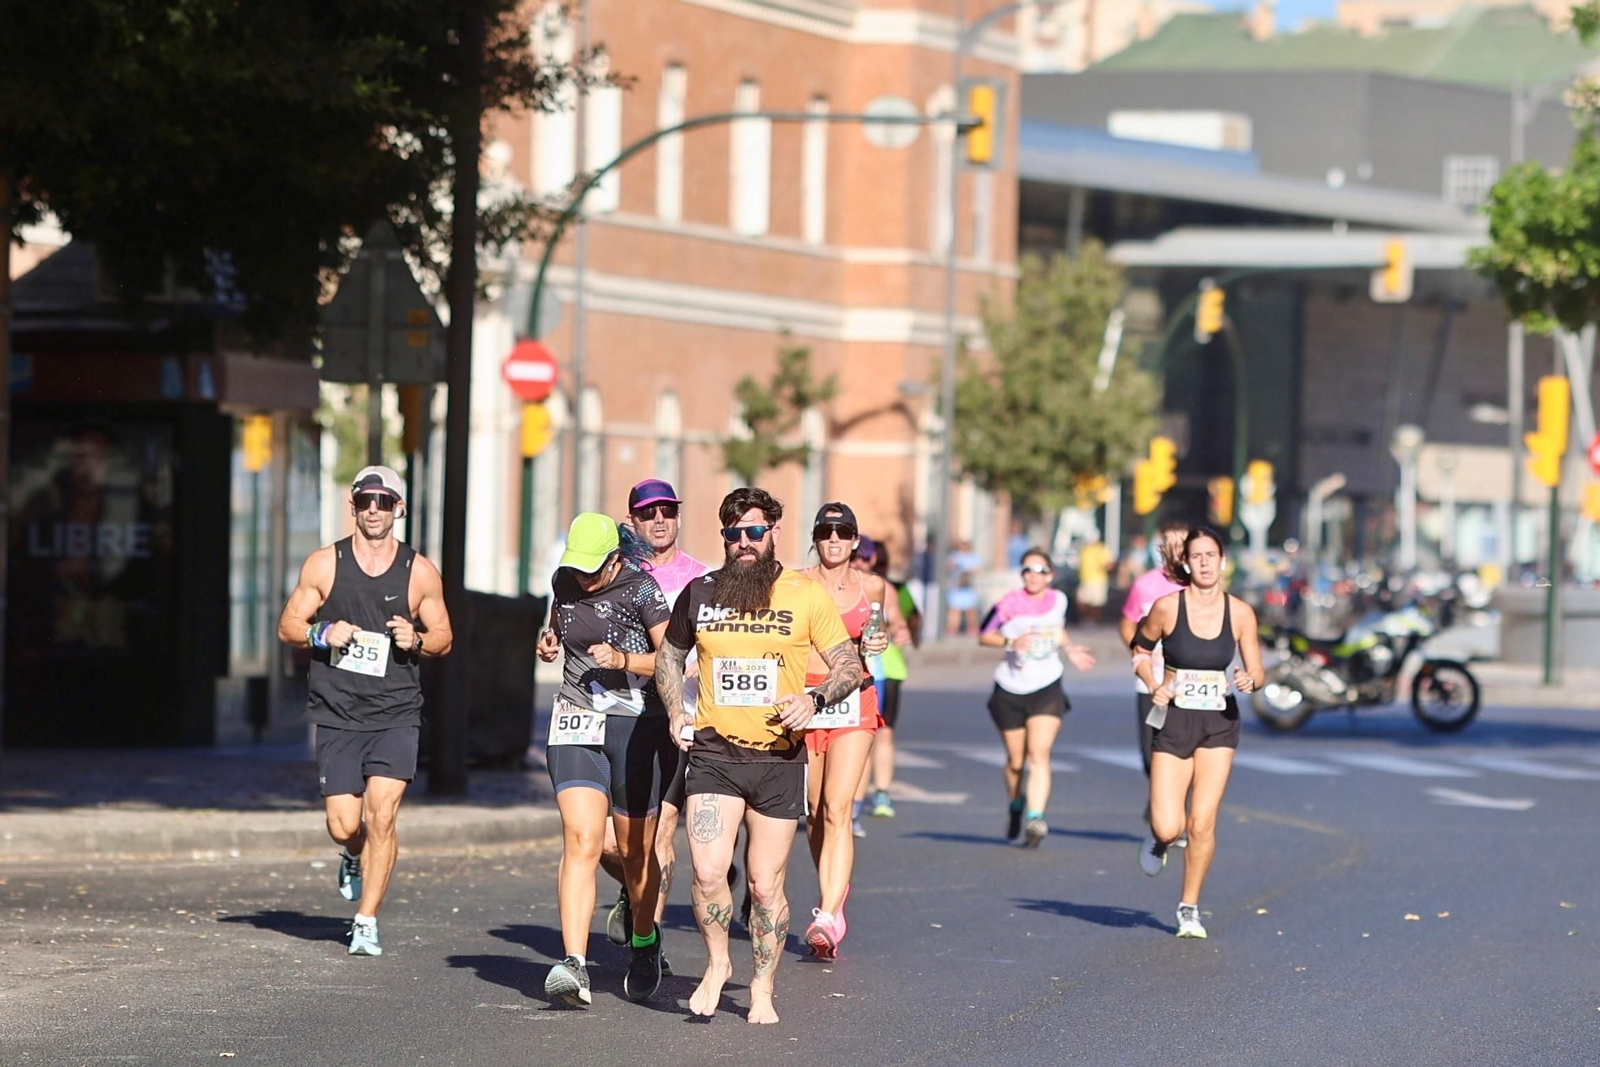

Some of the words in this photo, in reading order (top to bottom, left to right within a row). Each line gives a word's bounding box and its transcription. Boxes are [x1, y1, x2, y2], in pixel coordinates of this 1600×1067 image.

[28, 522, 151, 557] LIBRE
[696, 622, 791, 635] runners
[722, 674, 768, 690] 586
[1184, 684, 1218, 697] 241
[818, 701, 850, 715] 80
[558, 715, 594, 730] 507
